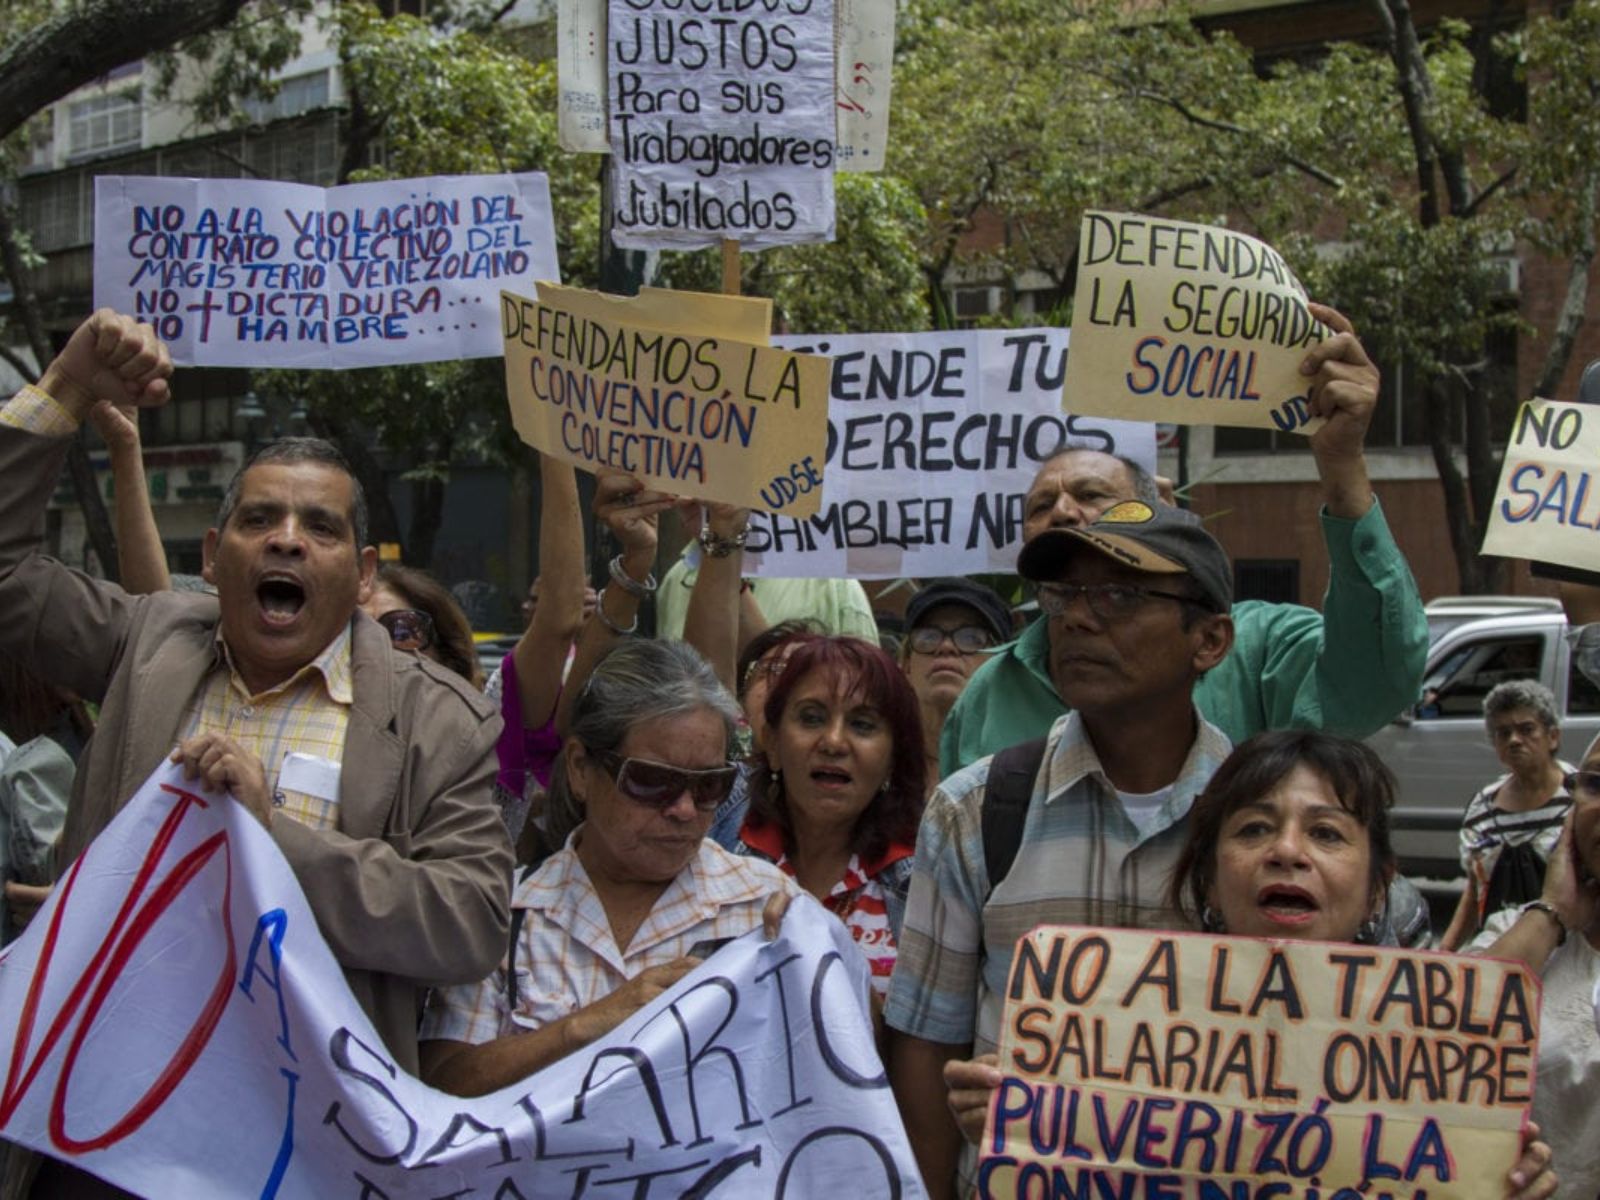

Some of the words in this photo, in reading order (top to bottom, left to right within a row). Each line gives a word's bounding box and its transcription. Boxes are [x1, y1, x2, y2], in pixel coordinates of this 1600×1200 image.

[616, 18, 797, 72] JUSTOS
[616, 71, 700, 114] Para
[614, 113, 833, 177] Trabajadores
[128, 231, 280, 264] CONTRATO
[294, 228, 452, 264] COLECTIVO
[467, 224, 531, 252] DEL
[134, 205, 185, 233] NO
[472, 195, 523, 225] DEL
[128, 259, 326, 290] MAGISTERIO
[338, 250, 529, 289] VENEZOLANO
[136, 289, 180, 314] NO
[1090, 278, 1136, 327] LA
[1164, 281, 1334, 349] SEGURIDA
[502, 296, 721, 392] DEFENDAMOS
[744, 347, 801, 409] LA
[1126, 336, 1261, 401] SOCIAL
[531, 356, 757, 448] CONVENCIÓN
[1516, 404, 1582, 450] NO
[561, 411, 707, 484] COLECTIVA
[760, 456, 823, 509] UDSE
[1502, 461, 1600, 531] SAL
[1009, 935, 1112, 1006] NO
[1122, 939, 1181, 1012] A
[1207, 946, 1305, 1020] LA
[1328, 953, 1536, 1043] TABLA
[1010, 1006, 1299, 1101] SALARIAL
[1323, 1032, 1533, 1107] ONAPRE
[990, 1077, 1334, 1180] PULVERIZÓ
[1362, 1112, 1455, 1184] LA
